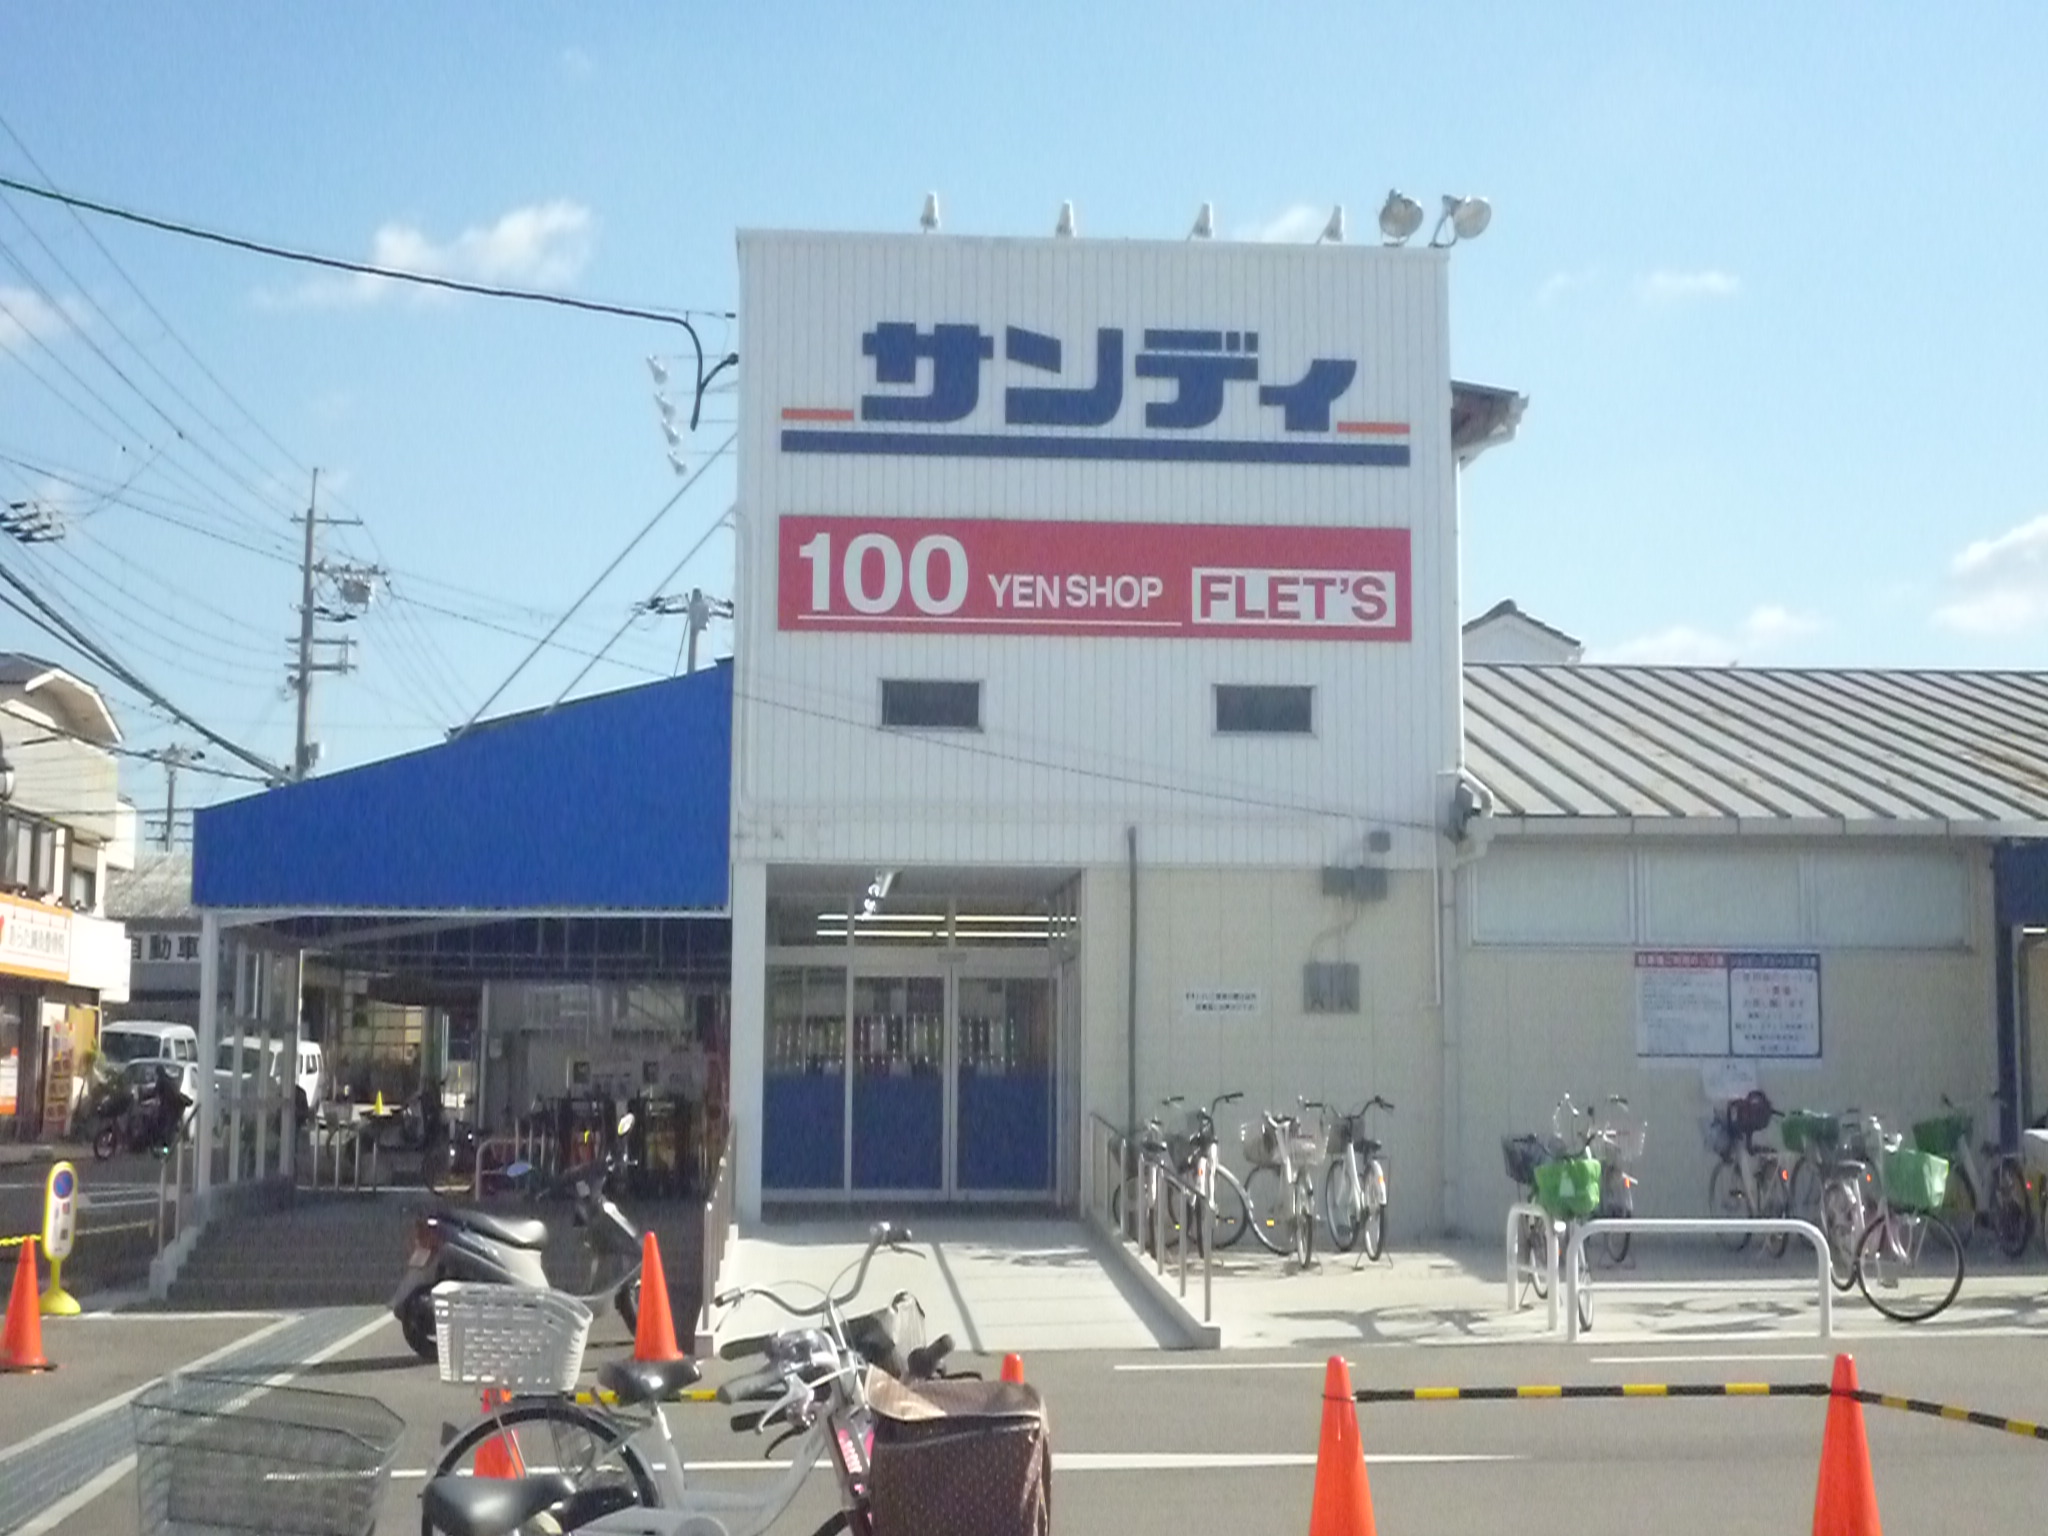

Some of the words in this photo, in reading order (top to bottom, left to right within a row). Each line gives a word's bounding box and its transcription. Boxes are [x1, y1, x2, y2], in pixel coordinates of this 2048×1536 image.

[861, 321, 1358, 433] サンディ
[799, 532, 969, 615] 100
[987, 573, 1060, 608] YEN
[1065, 574, 1163, 609] SHOP
[1200, 573, 1388, 622] FLET'S
